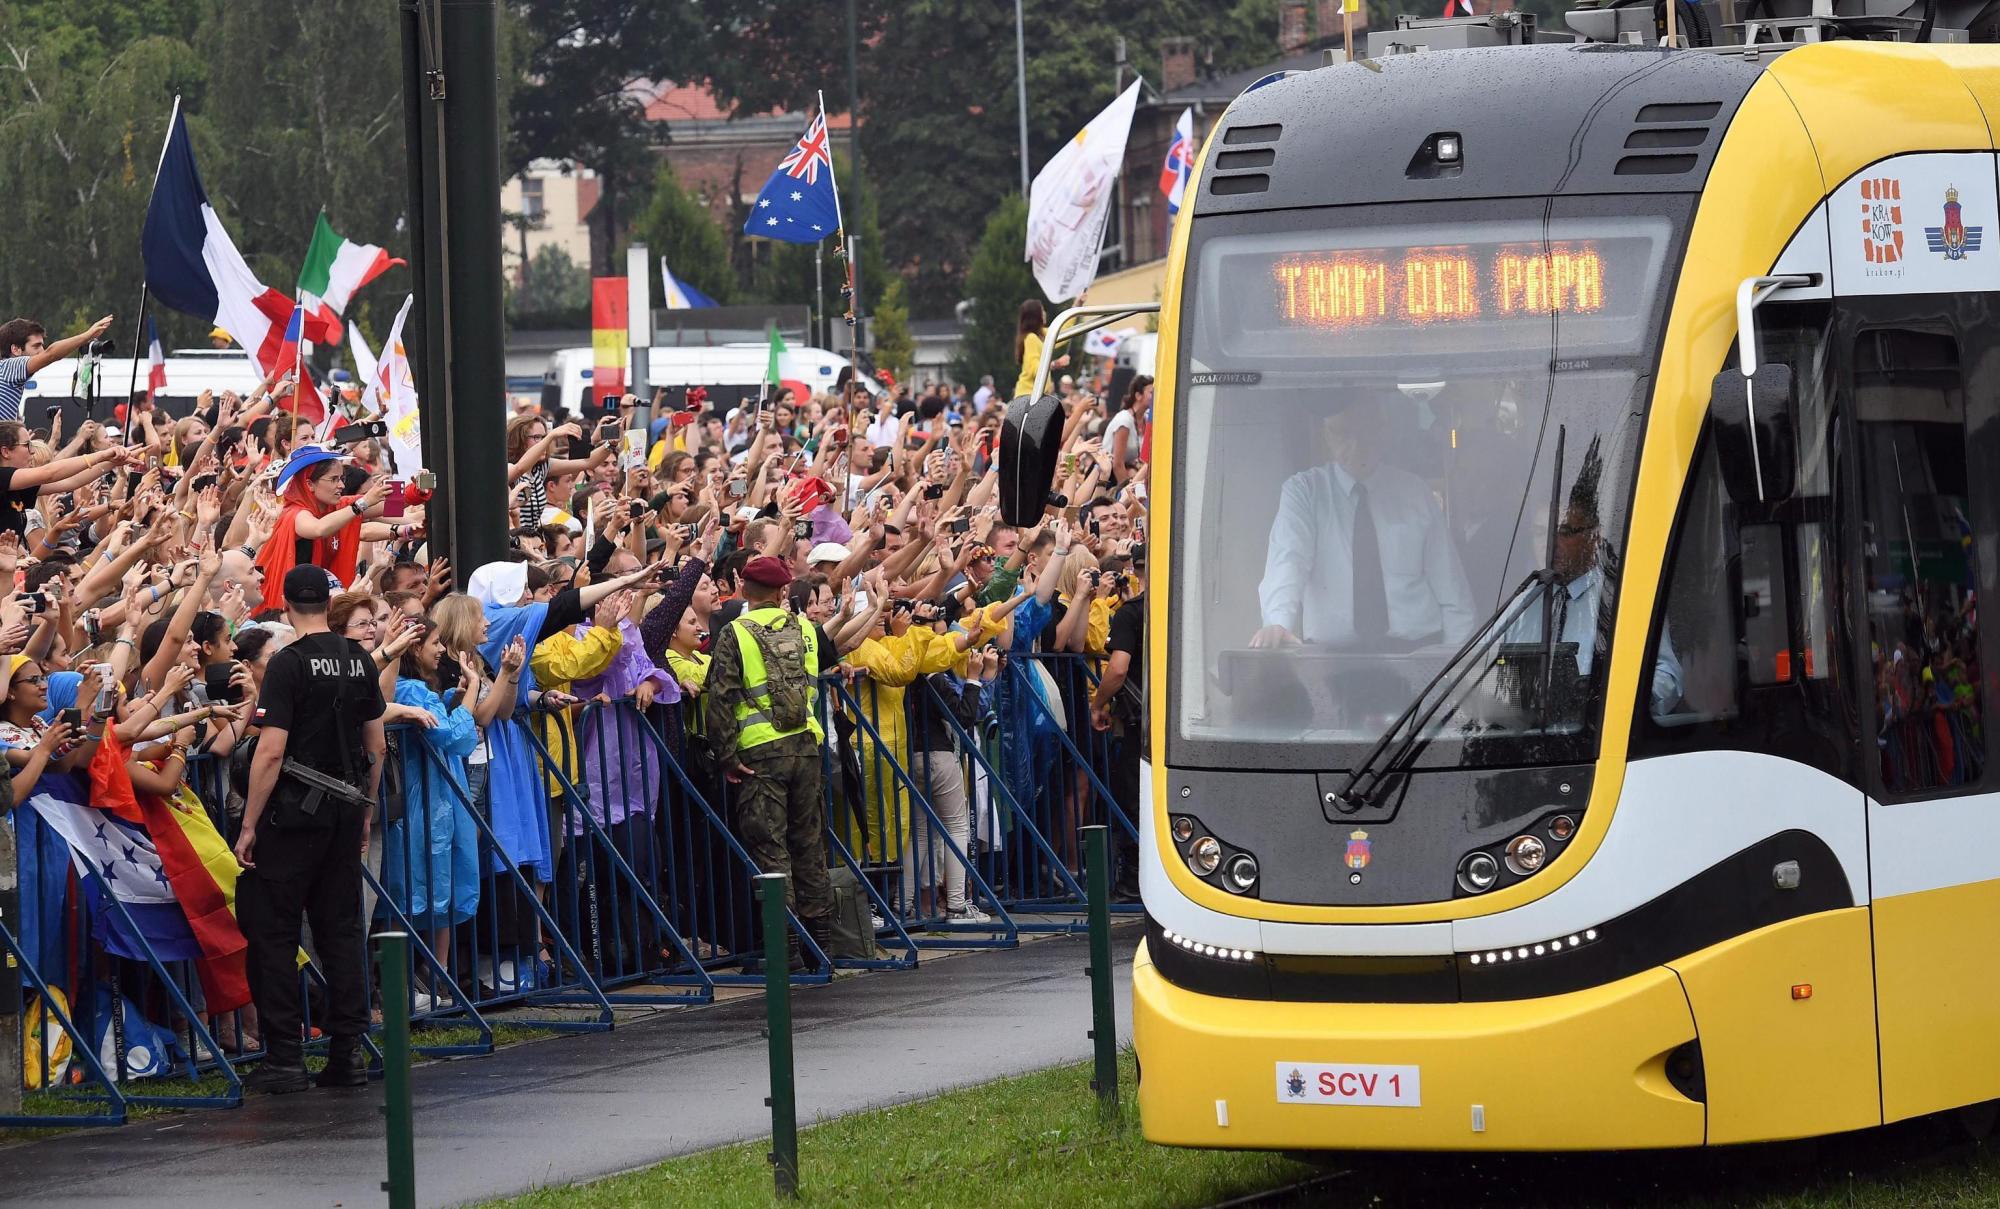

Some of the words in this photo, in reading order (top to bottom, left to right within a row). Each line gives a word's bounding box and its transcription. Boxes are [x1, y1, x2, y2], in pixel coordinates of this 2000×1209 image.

[1872, 204, 1889, 221] KRA
[1278, 261, 1386, 320] TRAM
[1405, 257, 1474, 317] DEL
[1501, 253, 1602, 313] PAPA
[1555, 359, 1589, 371] 2014N
[1192, 374, 1254, 384] KRAKOWIAK
[310, 658, 366, 678] POLIJA
[588, 884, 596, 902] KWP
[1318, 1071, 1379, 1097] SCV
[1389, 1074, 1401, 1098] 1
